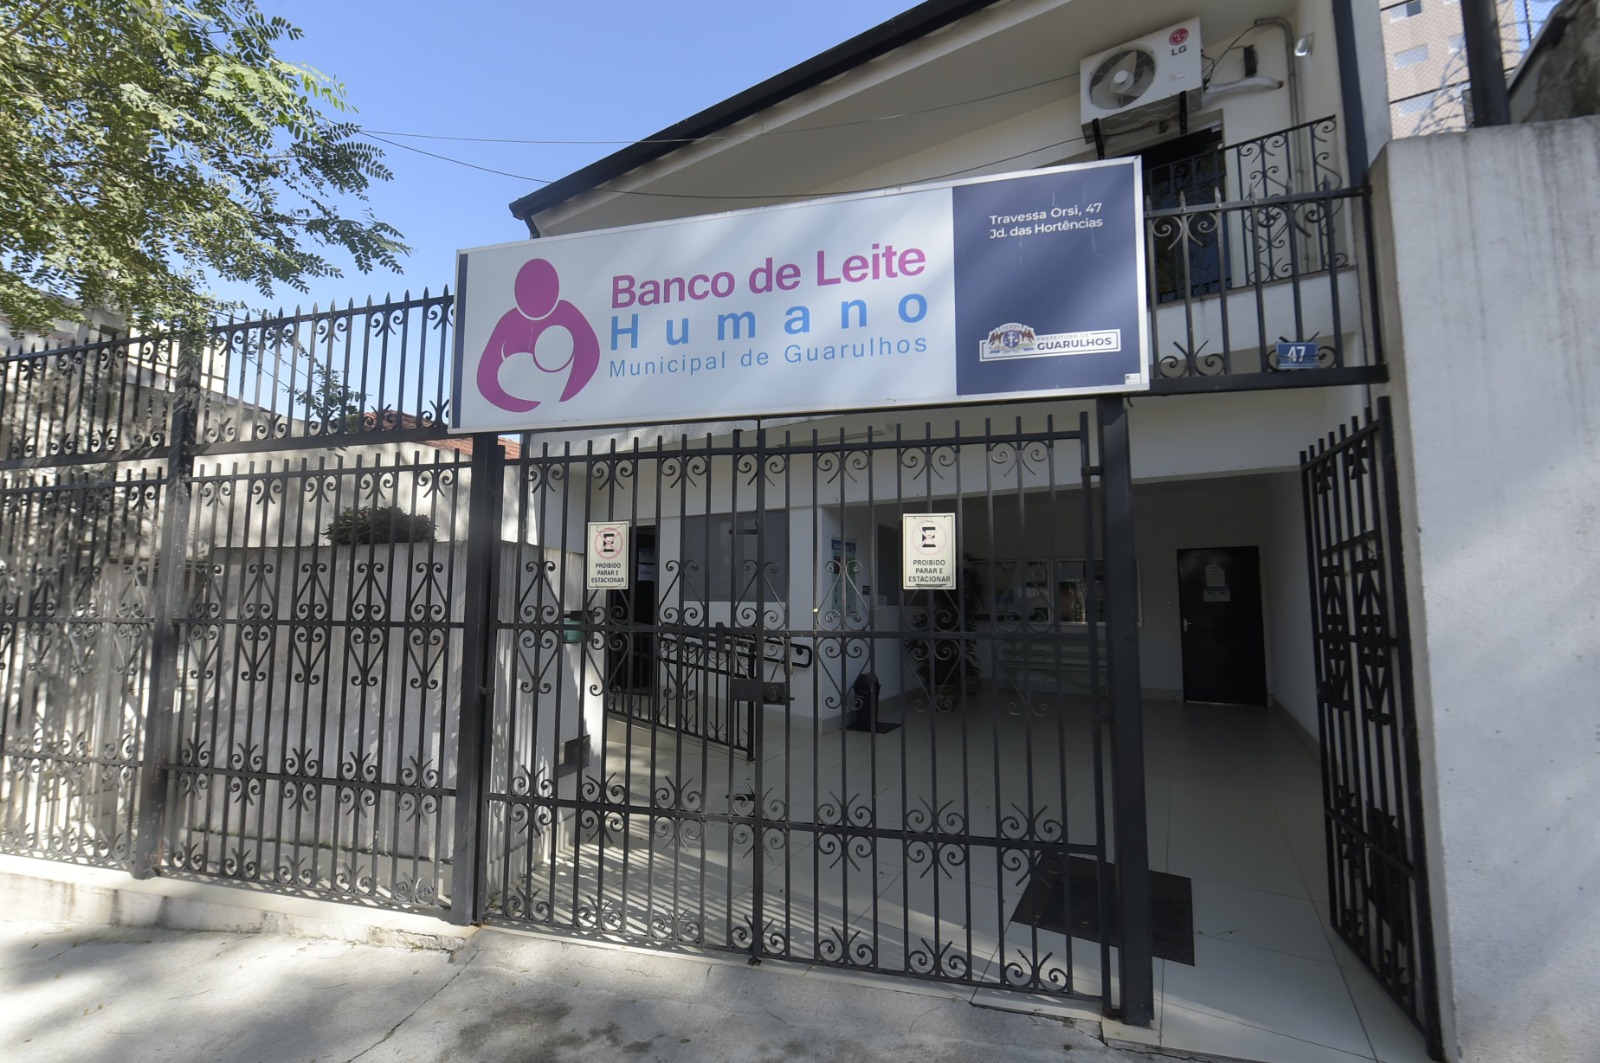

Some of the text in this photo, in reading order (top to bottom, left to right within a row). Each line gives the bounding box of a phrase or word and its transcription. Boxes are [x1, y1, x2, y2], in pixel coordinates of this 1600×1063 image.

[1171, 45, 1187, 56] LG
[989, 202, 1103, 225] Travessa Orsi, 47
[989, 217, 1103, 239] Jd. das Hortências
[611, 243, 926, 309] Banco de Leite
[1037, 337, 1112, 351] GUARULHOS
[1287, 345, 1306, 362] 47
[609, 336, 927, 378] Municipal de Guarulhos
[908, 575, 951, 583] ESTACIONAR
